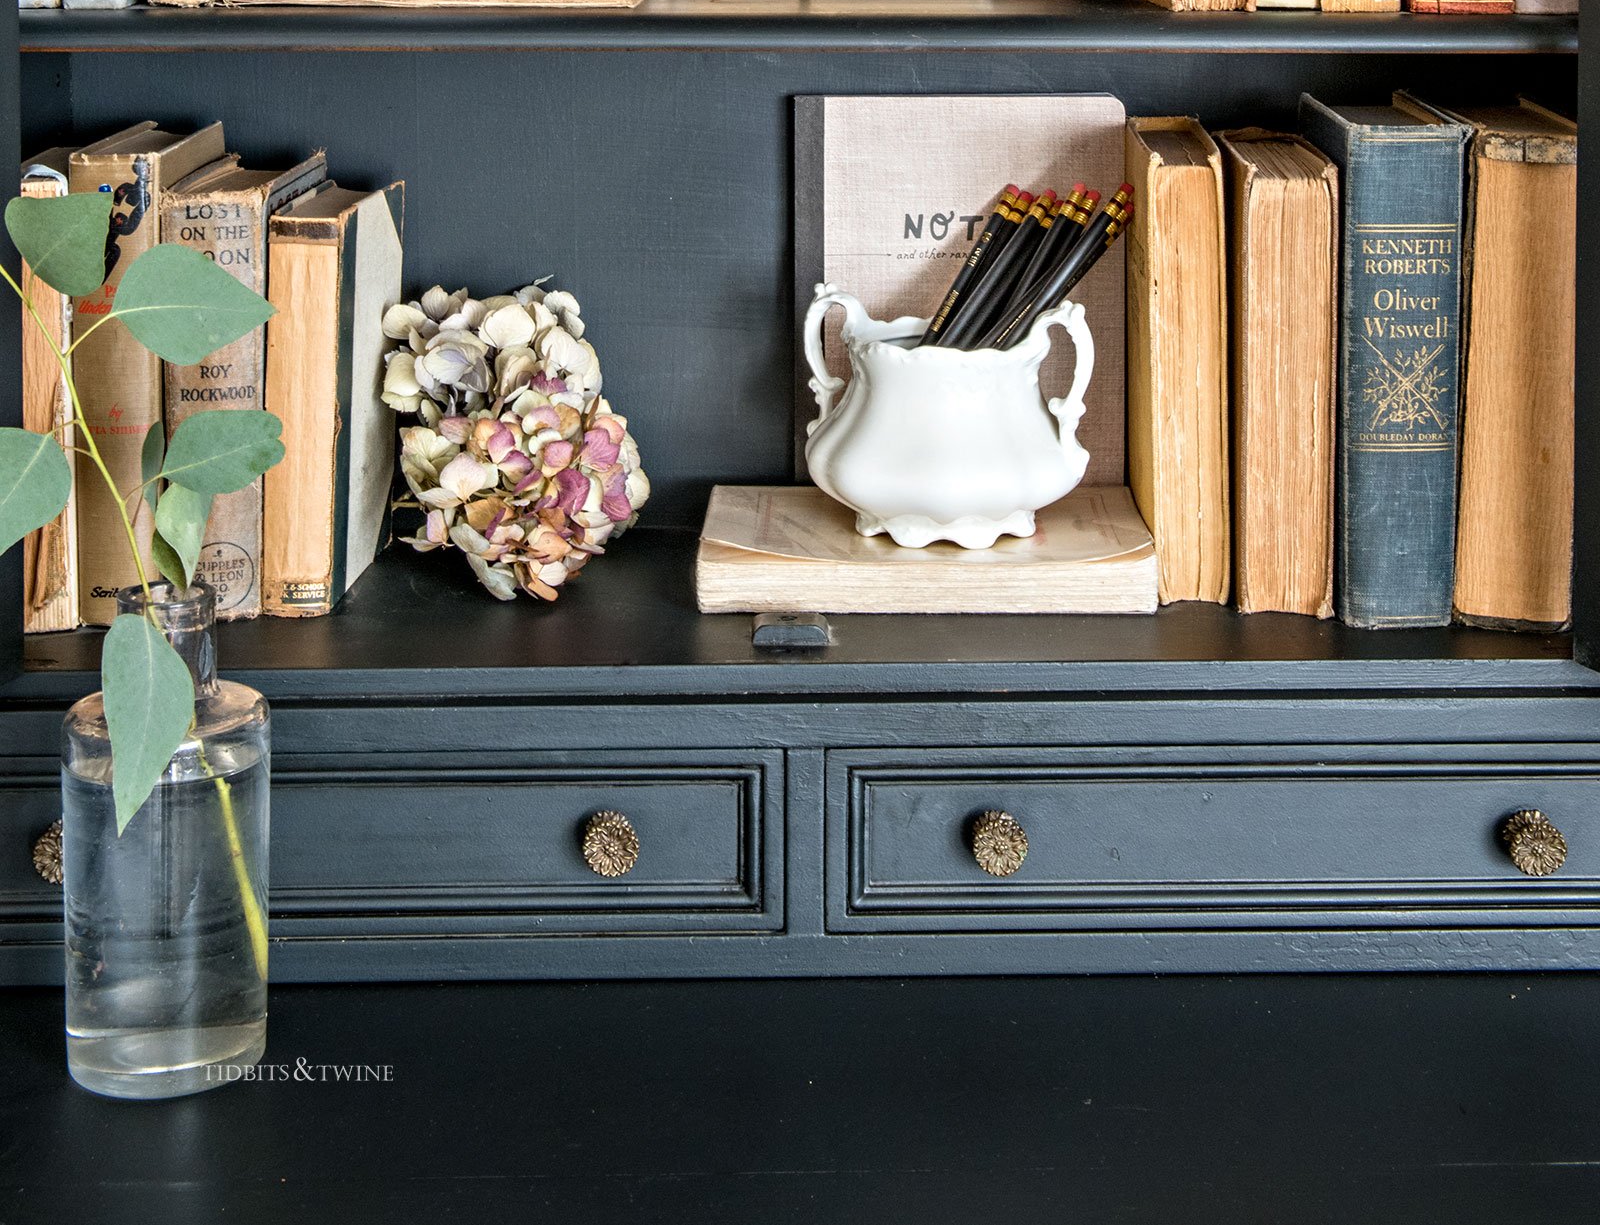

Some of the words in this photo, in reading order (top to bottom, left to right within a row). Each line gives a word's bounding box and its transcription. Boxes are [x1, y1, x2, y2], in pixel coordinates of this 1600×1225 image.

[185, 204, 241, 220] LOST
[180, 227, 206, 241] ON
[214, 226, 249, 240] THE
[896, 248, 915, 259] and
[919, 247, 946, 259] other
[1362, 239, 1452, 255] KENNETH
[1365, 259, 1450, 275] ROBERTS
[1373, 289, 1441, 311] Oliver
[1364, 316, 1449, 339] Wiswell
[200, 364, 232, 379] ROY
[180, 385, 256, 401] ROCKWOOD
[1359, 432, 1415, 442] DOUBLEDAY
[196, 558, 246, 572] CUPPLES
[211, 570, 244, 582] LEON
[292, 590, 326, 599] SERVICE
